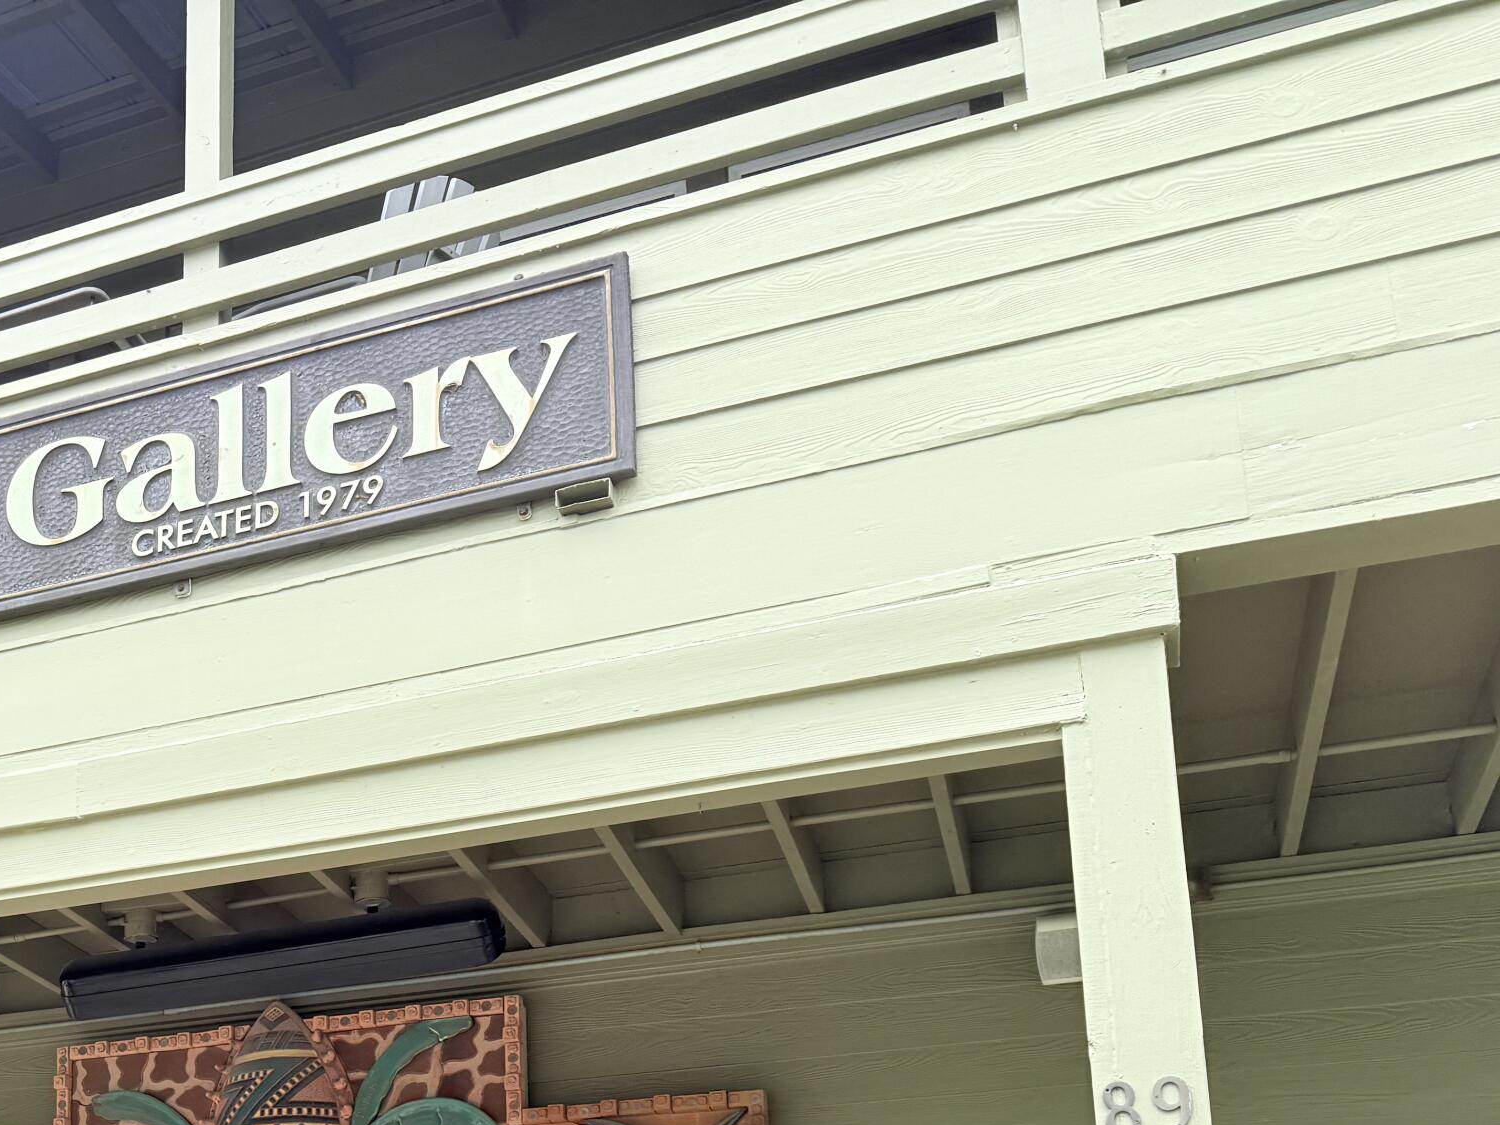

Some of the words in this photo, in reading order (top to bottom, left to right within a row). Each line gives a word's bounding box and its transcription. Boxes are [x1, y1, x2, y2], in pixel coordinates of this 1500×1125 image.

[6, 331, 578, 549] Gallery
[131, 499, 280, 558] CREATED
[299, 474, 385, 518] 1979
